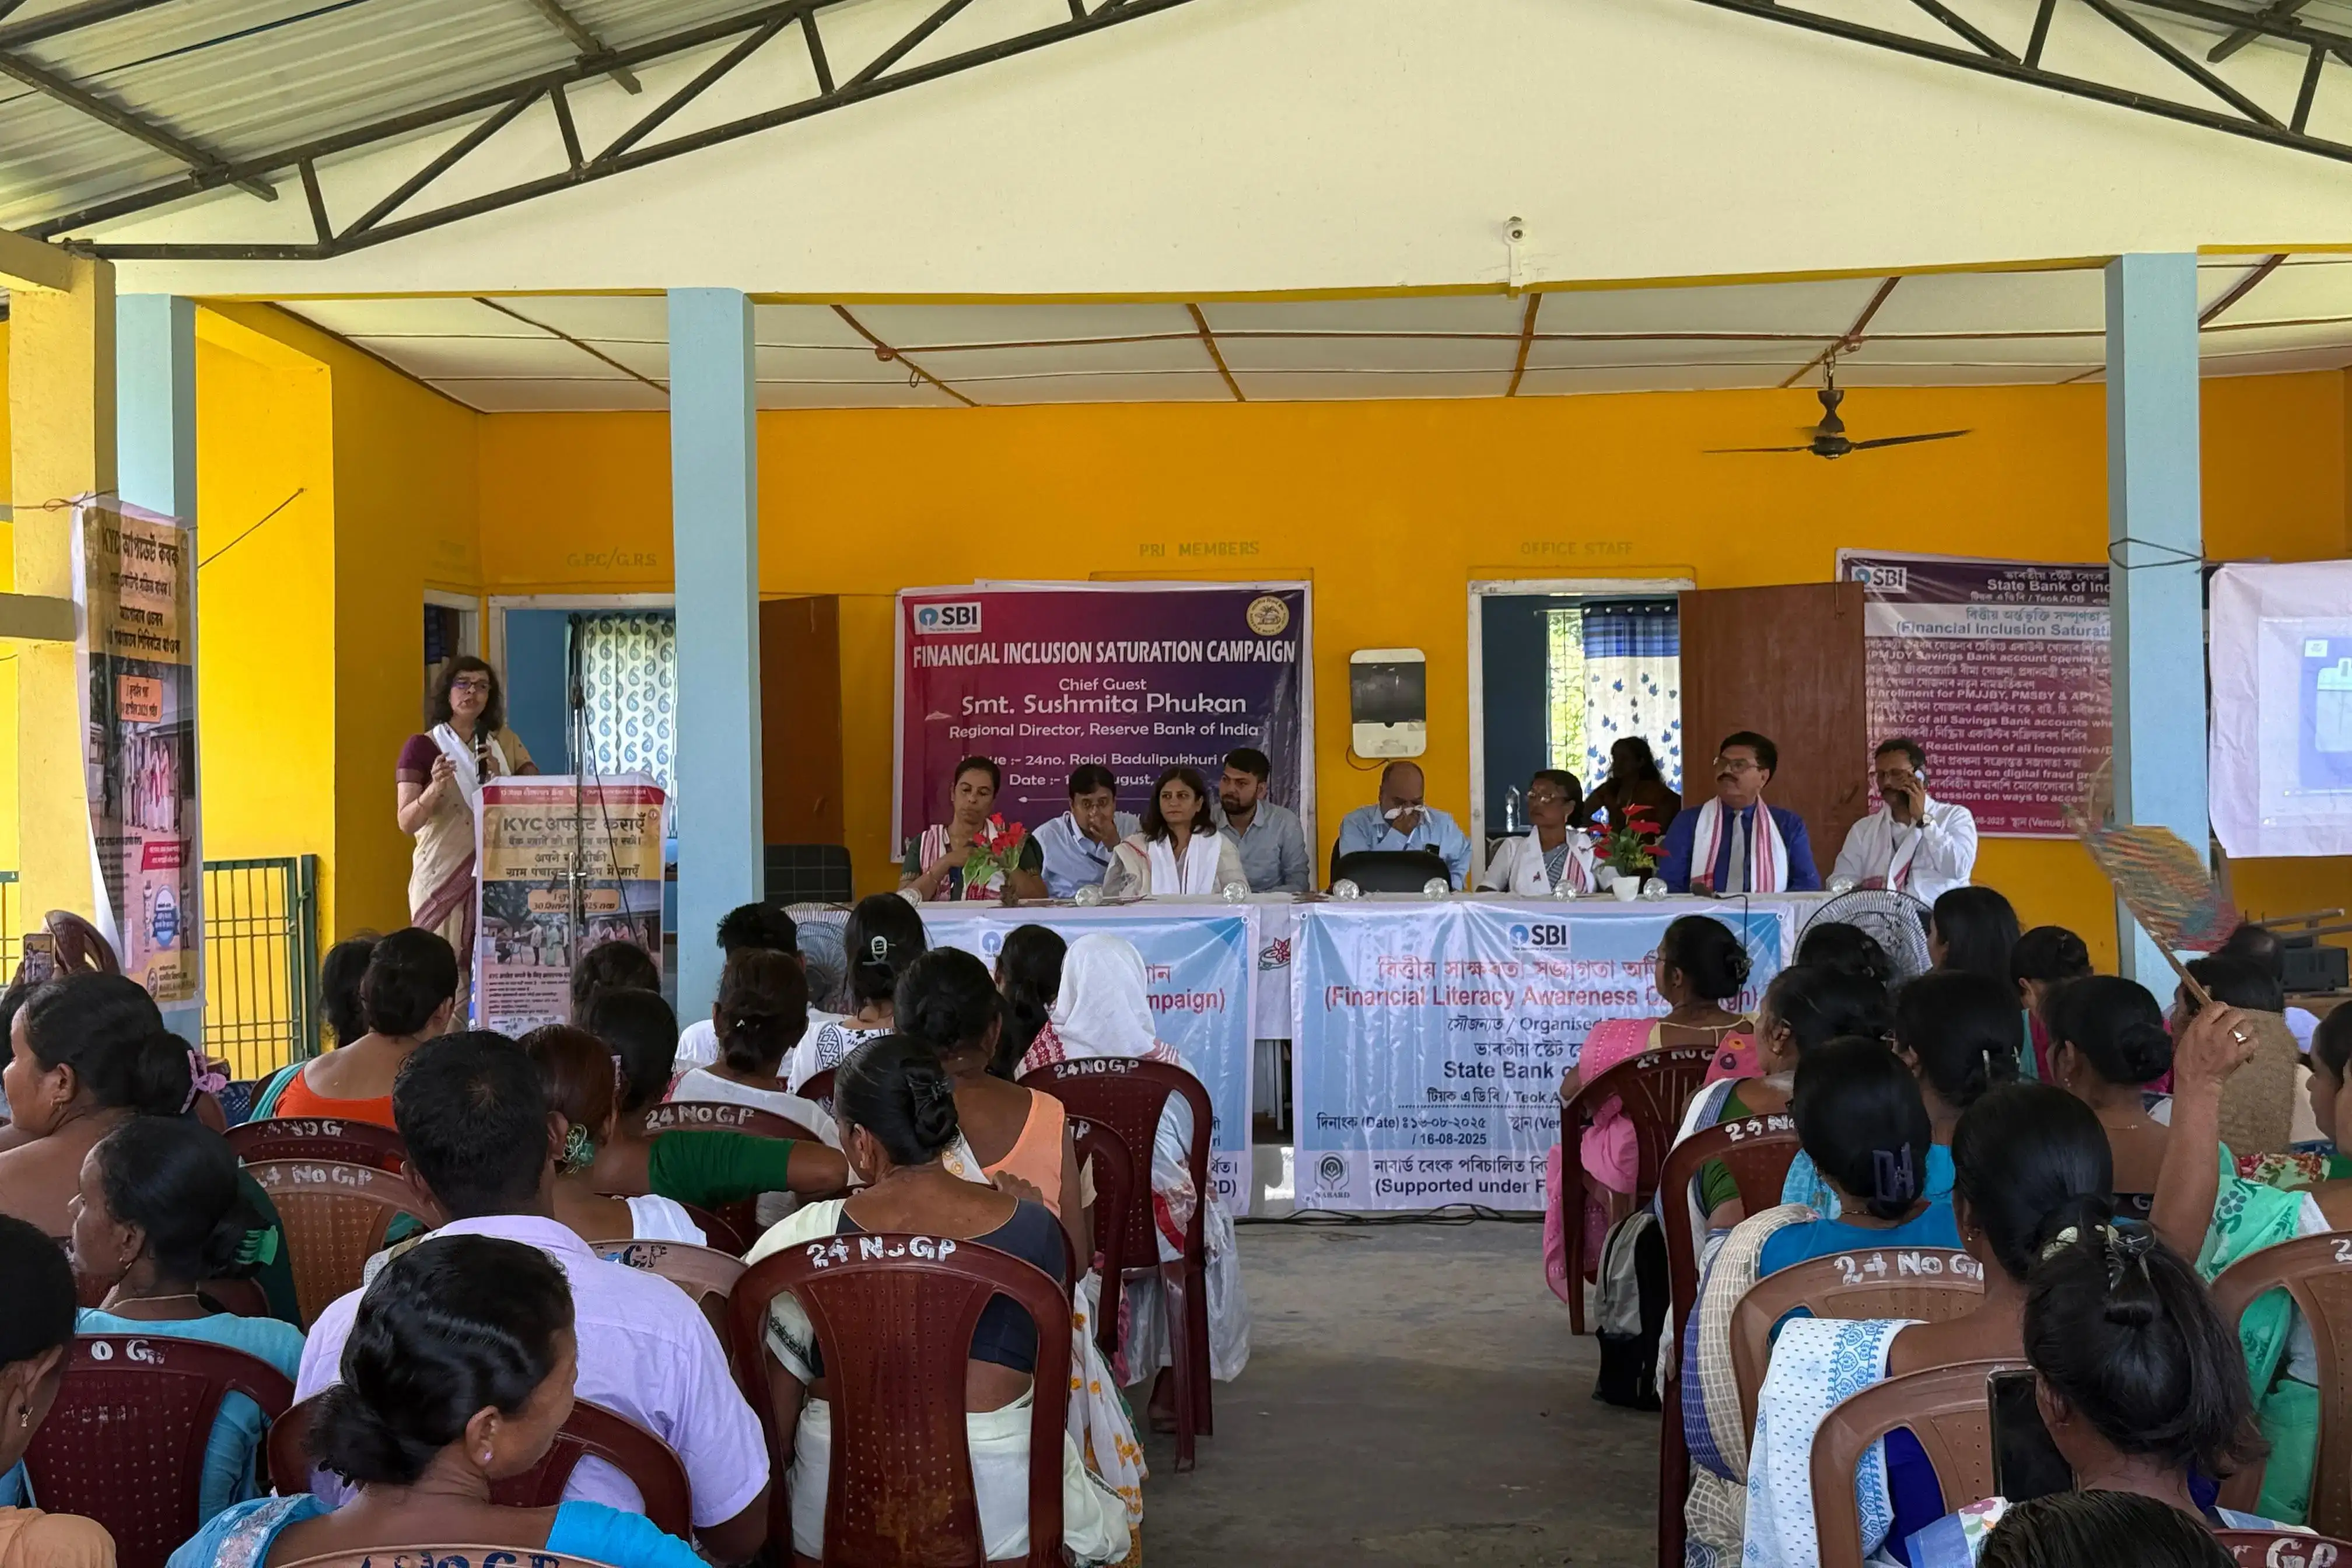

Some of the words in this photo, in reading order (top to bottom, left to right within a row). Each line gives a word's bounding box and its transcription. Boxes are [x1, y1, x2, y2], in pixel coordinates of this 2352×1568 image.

[1139, 544, 1166, 556] PRI
[1873, 569, 1903, 587] SBI
[1987, 579, 2025, 592] State
[2029, 579, 2067, 592] Bank
[2071, 580, 2086, 593] of
[942, 606, 977, 625] SBI
[1896, 621, 1971, 636] (Financial
[1976, 622, 2045, 637] Inclusion
[2050, 623, 2110, 639] Saturati
[914, 642, 1000, 668] FINANCIAL
[1003, 642, 1091, 664] INCLUSION
[1096, 641, 1203, 663] SATURATION
[1207, 640, 1295, 663] CAMPAIGN
[1916, 651, 1964, 662] Savings
[1967, 652, 1997, 661] Bank
[2000, 653, 2048, 663] account
[1059, 678, 1099, 691] Chief
[1103, 678, 1147, 691] Guest
[1937, 689, 1955, 698] for
[2059, 691, 2067, 700] &
[963, 696, 1015, 716] Smt.
[1024, 694, 1138, 714] Sushmita
[1146, 692, 1246, 713] Phukan
[1918, 714, 1931, 723] of
[1933, 715, 1948, 724] all
[1951, 715, 1998, 726] Savings
[2001, 716, 2031, 726] Bank
[2034, 718, 2088, 727] accounts
[949, 723, 1014, 740] Regional
[1020, 724, 1084, 737] Director,
[1090, 724, 1149, 736] Reserve
[1153, 722, 1195, 735] Bank
[1200, 722, 1216, 735] of
[1220, 722, 1259, 736] India
[1926, 741, 1999, 752] Reactivation
[2002, 743, 2015, 752] of
[2017, 743, 2031, 753] all
[2034, 744, 2113, 755] Inoperative/D
[1026, 755, 1065, 765] 24no.
[1010, 774, 1046, 786] Date
[1114, 775, 1154, 786] ugust,
[1936, 768, 1982, 776] session
[1985, 769, 2000, 777] on
[2003, 769, 2039, 779] digital
[2042, 771, 2074, 779] fraud
[1935, 791, 1981, 800] session
[1984, 793, 1999, 801] on
[2002, 793, 2032, 803] ways
[2036, 793, 2048, 802] to
[503, 818, 542, 832] KYC
[545, 818, 596, 832] अपट
[2028, 817, 2064, 830] (Venue)
[1531, 925, 1566, 945] SBI
[1147, 989, 1225, 1013] mpaign)
[1325, 985, 1426, 1012] (Financial
[1433, 985, 1515, 1010] Literacy
[1521, 986, 1638, 1007] Awareness
[1507, 1017, 1514, 1033] /
[1054, 1062, 1079, 1079] 24
[1109, 1059, 1139, 1074] GP
[1444, 1060, 1495, 1079] State
[1503, 1060, 1553, 1079] Bank
[1513, 1090, 1546, 1103] Teok
[645, 1106, 674, 1129] 24
[716, 1105, 755, 1125] GP
[1361, 1115, 1399, 1130] (Date)
[322, 1120, 343, 1137] G
[1420, 1133, 1488, 1145] 16-08-2025
[1376, 1178, 1472, 1196] (Supported
[1479, 1180, 1531, 1194] under
[1535, 1180, 1546, 1194] F
[909, 1236, 956, 1262] GP
[2330, 1238, 2352, 1262] 2
